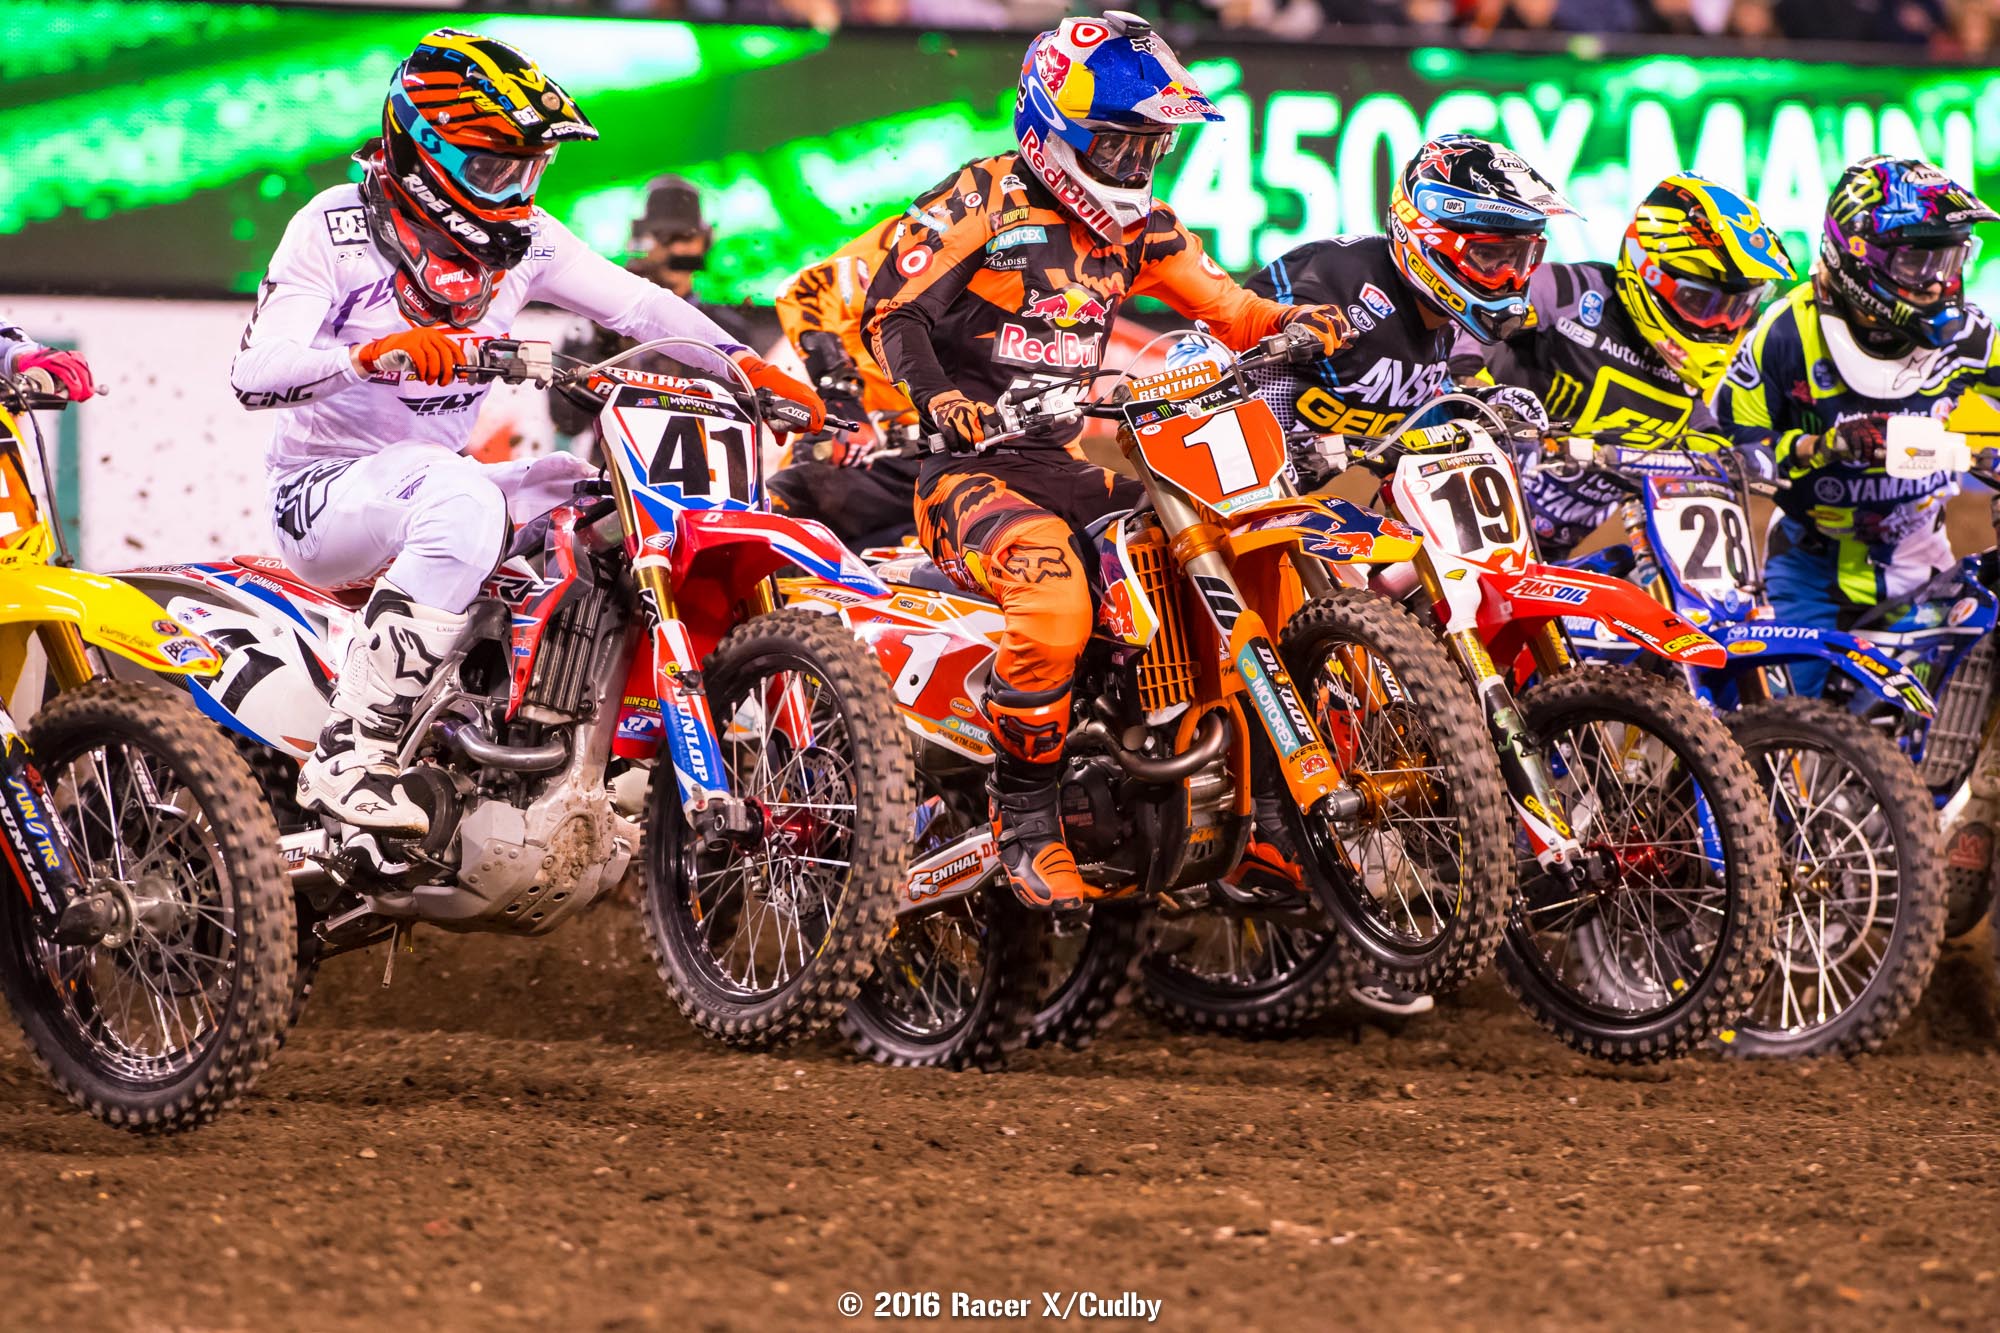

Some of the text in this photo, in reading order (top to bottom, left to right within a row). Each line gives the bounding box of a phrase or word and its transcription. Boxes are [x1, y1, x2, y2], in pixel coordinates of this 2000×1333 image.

[402, 173, 491, 245] RIDE RED
[1363, 288, 1394, 315] 100%
[1407, 252, 1467, 313] GEICO
[1132, 361, 1211, 389] RENTHAL
[1138, 372, 1216, 401] RENTHAL
[670, 396, 719, 412] MONSTER
[649, 415, 751, 505] 41
[1182, 408, 1260, 496] 1
[1430, 466, 1521, 554] 19
[1679, 504, 1753, 588] 28
[249, 574, 283, 594] CANARD
[1513, 578, 1589, 604] AMSOIL
[1613, 619, 1660, 644] DUNLOP
[1750, 626, 1819, 640] TOYOTA
[892, 631, 952, 708] 1
[671, 685, 709, 782] DUNLOP
[1251, 677, 1297, 753] MOTOREX
[1523, 794, 1571, 836] GEICO
